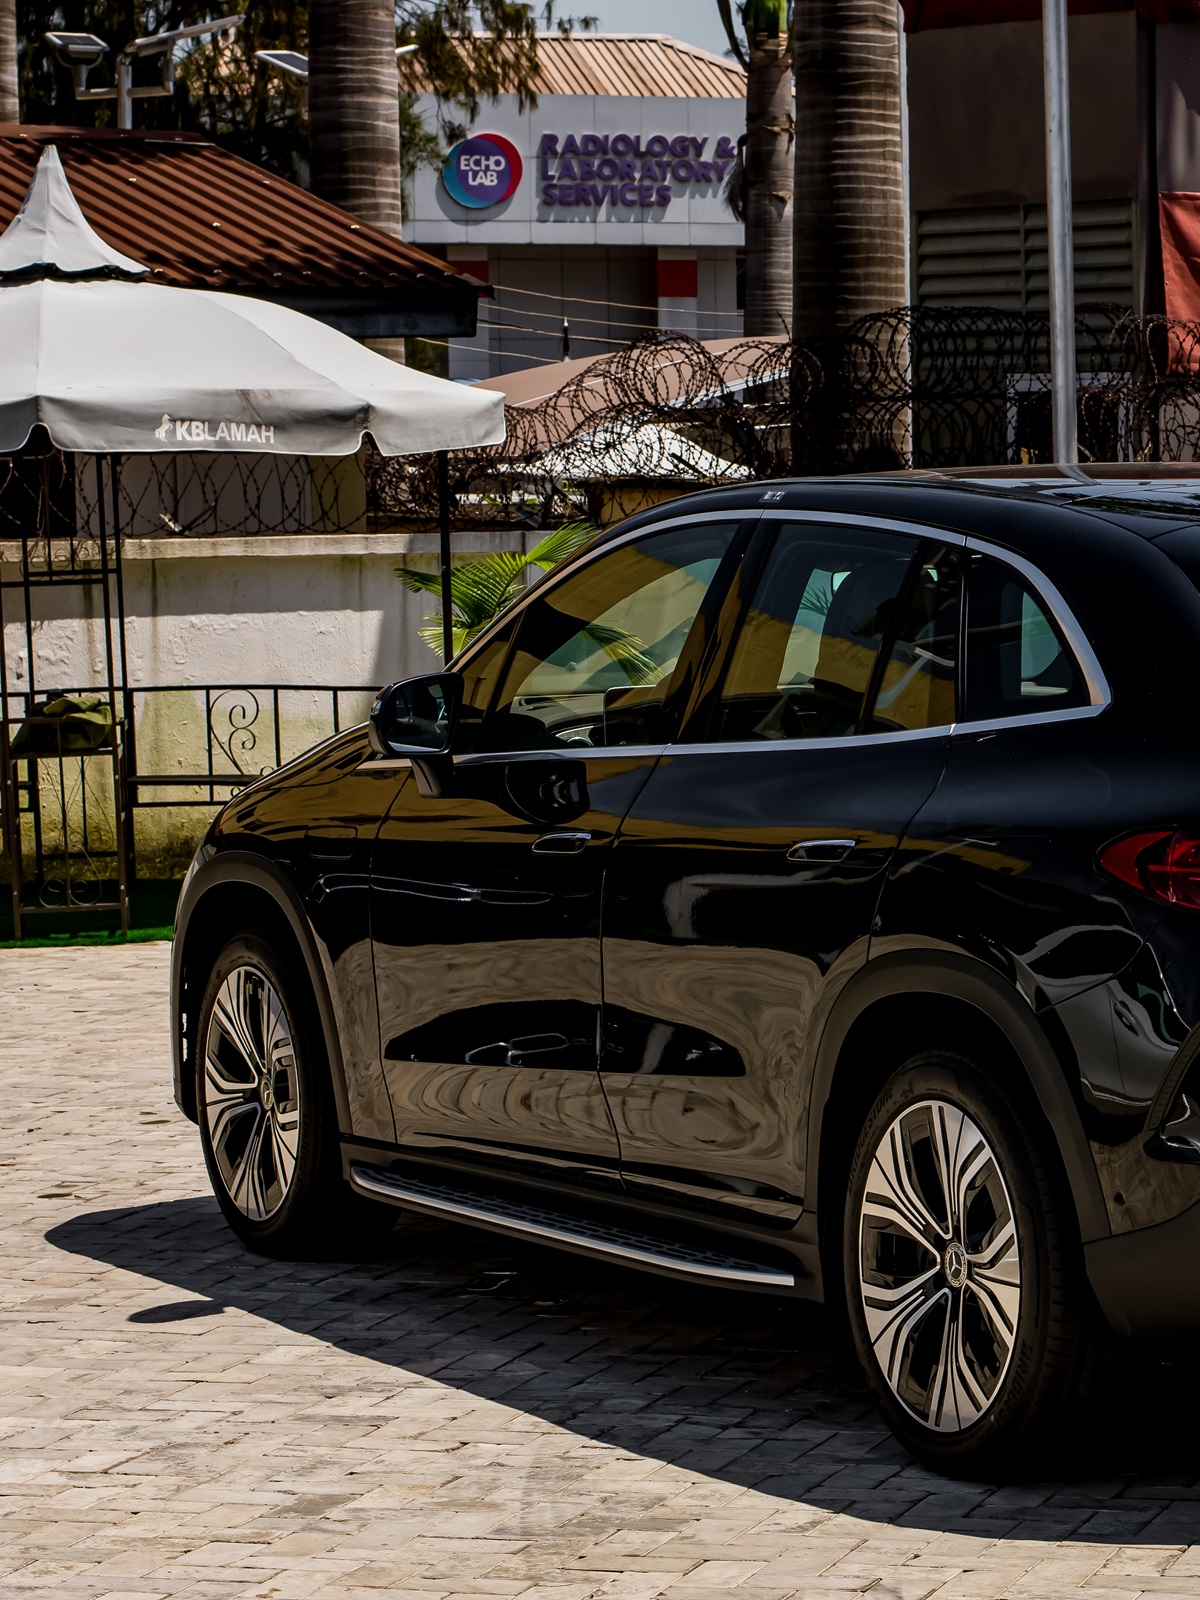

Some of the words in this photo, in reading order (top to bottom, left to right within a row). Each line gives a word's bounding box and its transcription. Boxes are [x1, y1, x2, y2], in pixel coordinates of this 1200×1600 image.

[541, 133, 708, 158] RADIOLOGY
[716, 136, 736, 159] &
[460, 155, 506, 171] ECHO
[541, 158, 731, 184] LABORATORY
[468, 170, 498, 187] LAB
[542, 183, 672, 207] SERVICES
